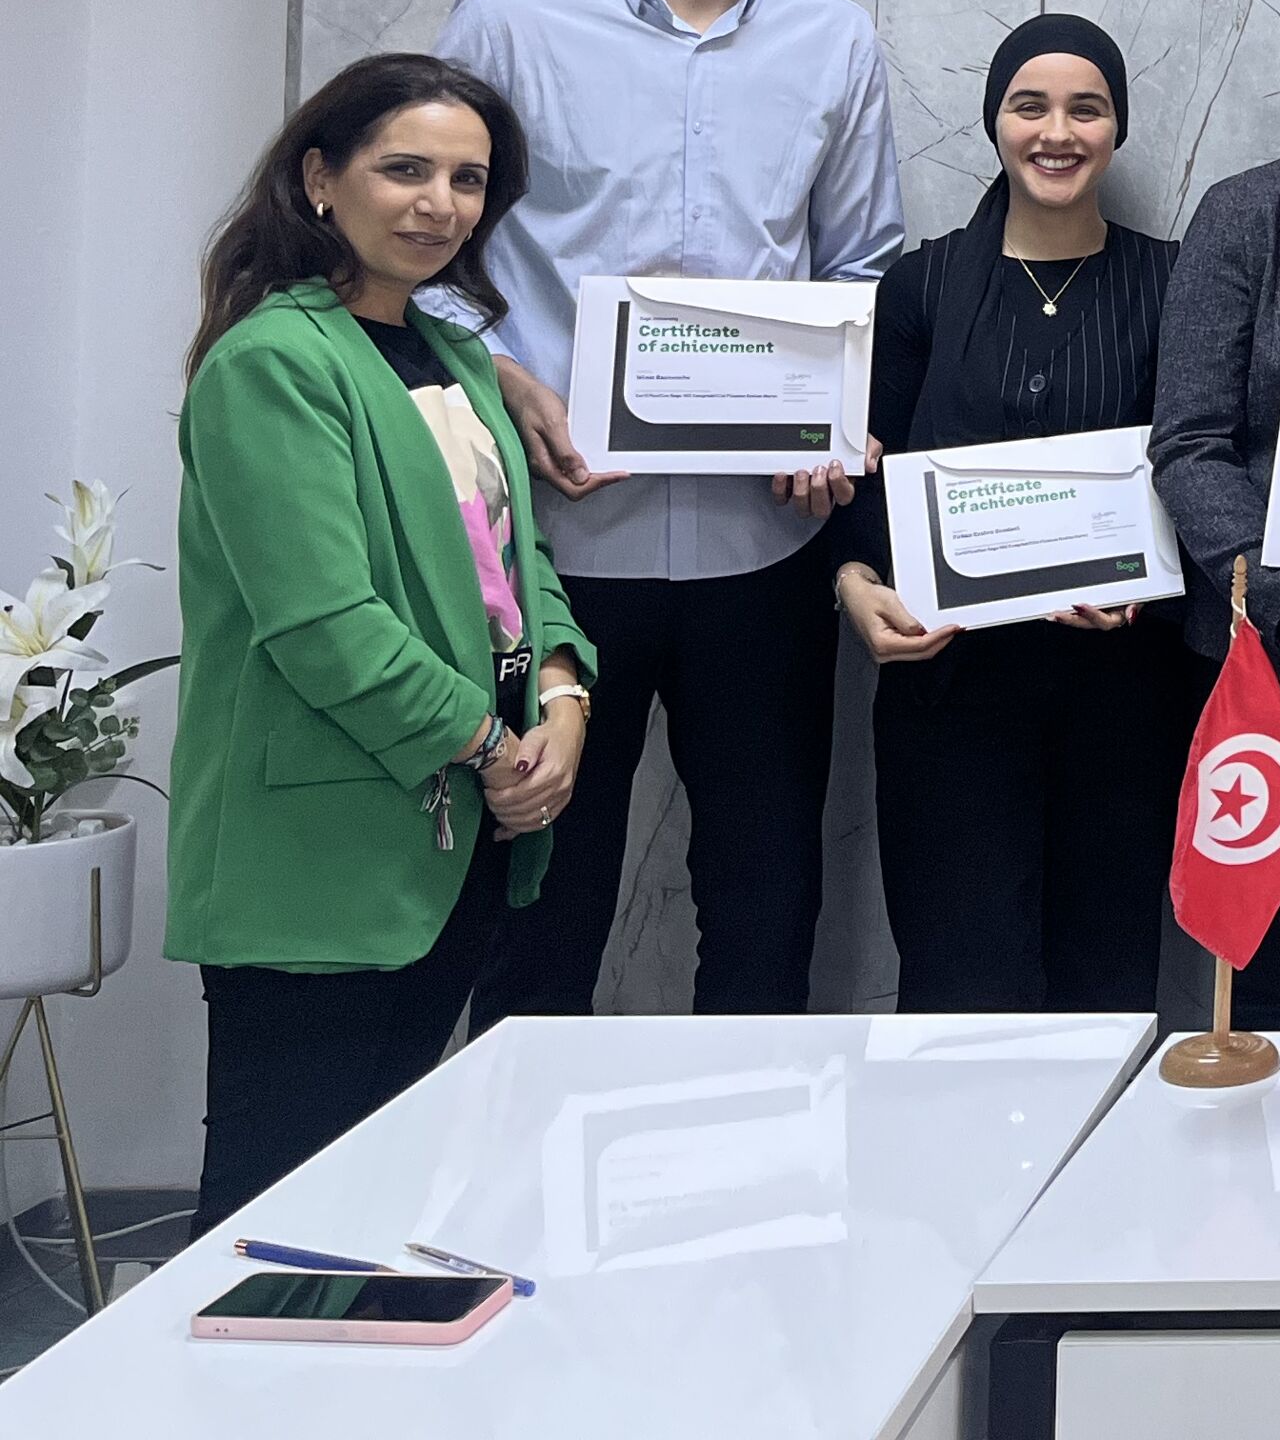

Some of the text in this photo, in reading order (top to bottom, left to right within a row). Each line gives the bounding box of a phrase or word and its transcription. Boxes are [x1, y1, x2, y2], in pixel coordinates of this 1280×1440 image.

[639, 324, 740, 338] Certificate
[638, 340, 775, 353] of achievement
[800, 429, 825, 444] Sage
[947, 480, 1042, 501] Certificate
[948, 488, 1077, 515] of achievement
[1115, 560, 1140, 573] Sage
